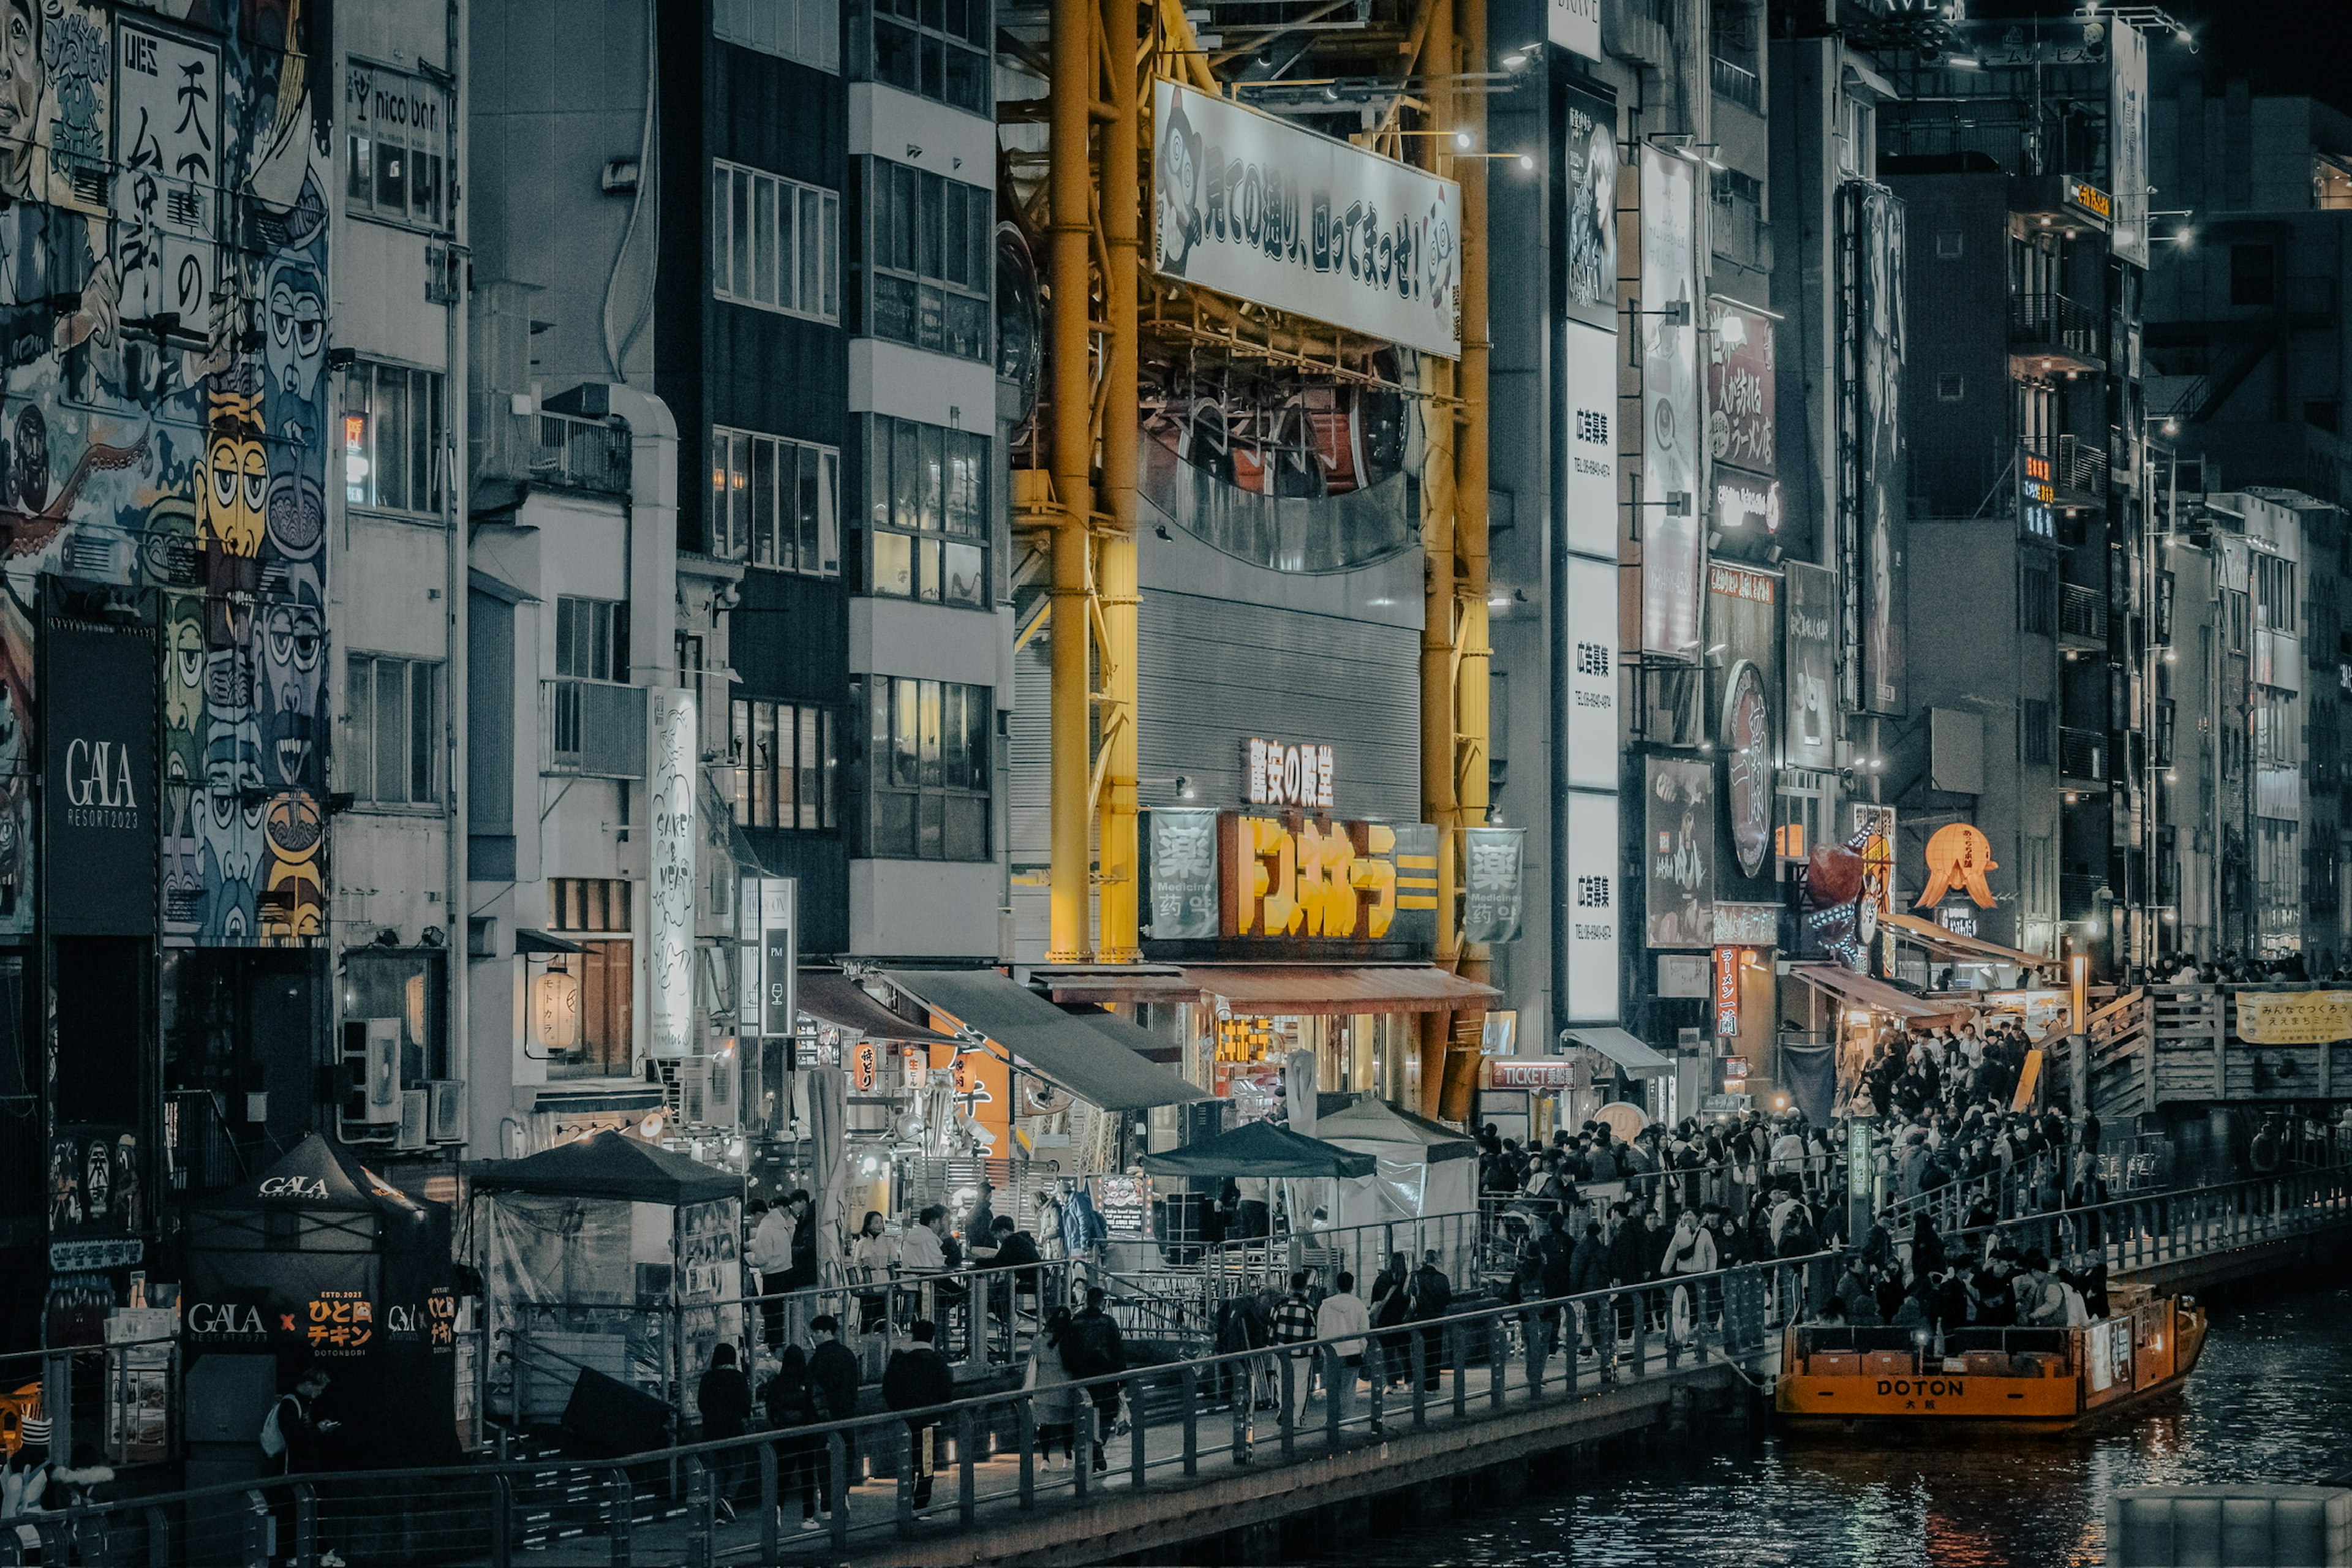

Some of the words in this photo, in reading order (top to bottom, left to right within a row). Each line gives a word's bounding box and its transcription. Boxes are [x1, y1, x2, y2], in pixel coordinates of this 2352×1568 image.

[376, 91, 406, 124] nico
[411, 94, 435, 132] bar
[1577, 407, 1609, 448] 広告募集
[1577, 640, 1610, 679] 広告募集
[66, 738, 138, 808] GALA
[67, 809, 138, 829] RESORT2023
[1158, 826, 1210, 879] 薬
[1472, 844, 1517, 890] 薬
[1158, 882, 1211, 892] Medicine
[1471, 892, 1519, 902] Medicine
[1577, 875, 1610, 908] 広告募集
[771, 947, 783, 957] PM
[542, 978, 553, 1036] モトカラ
[2263, 1005, 2348, 1015] みんなでつくろう
[2269, 1016, 2343, 1025] ええまちミナミ
[1504, 1067, 1547, 1085] TICKET
[259, 1175, 329, 1194] GALA
[187, 1302, 267, 1333] GALA
[307, 1323, 372, 1348] チキン
[1877, 1380, 1964, 1396] DOTON
